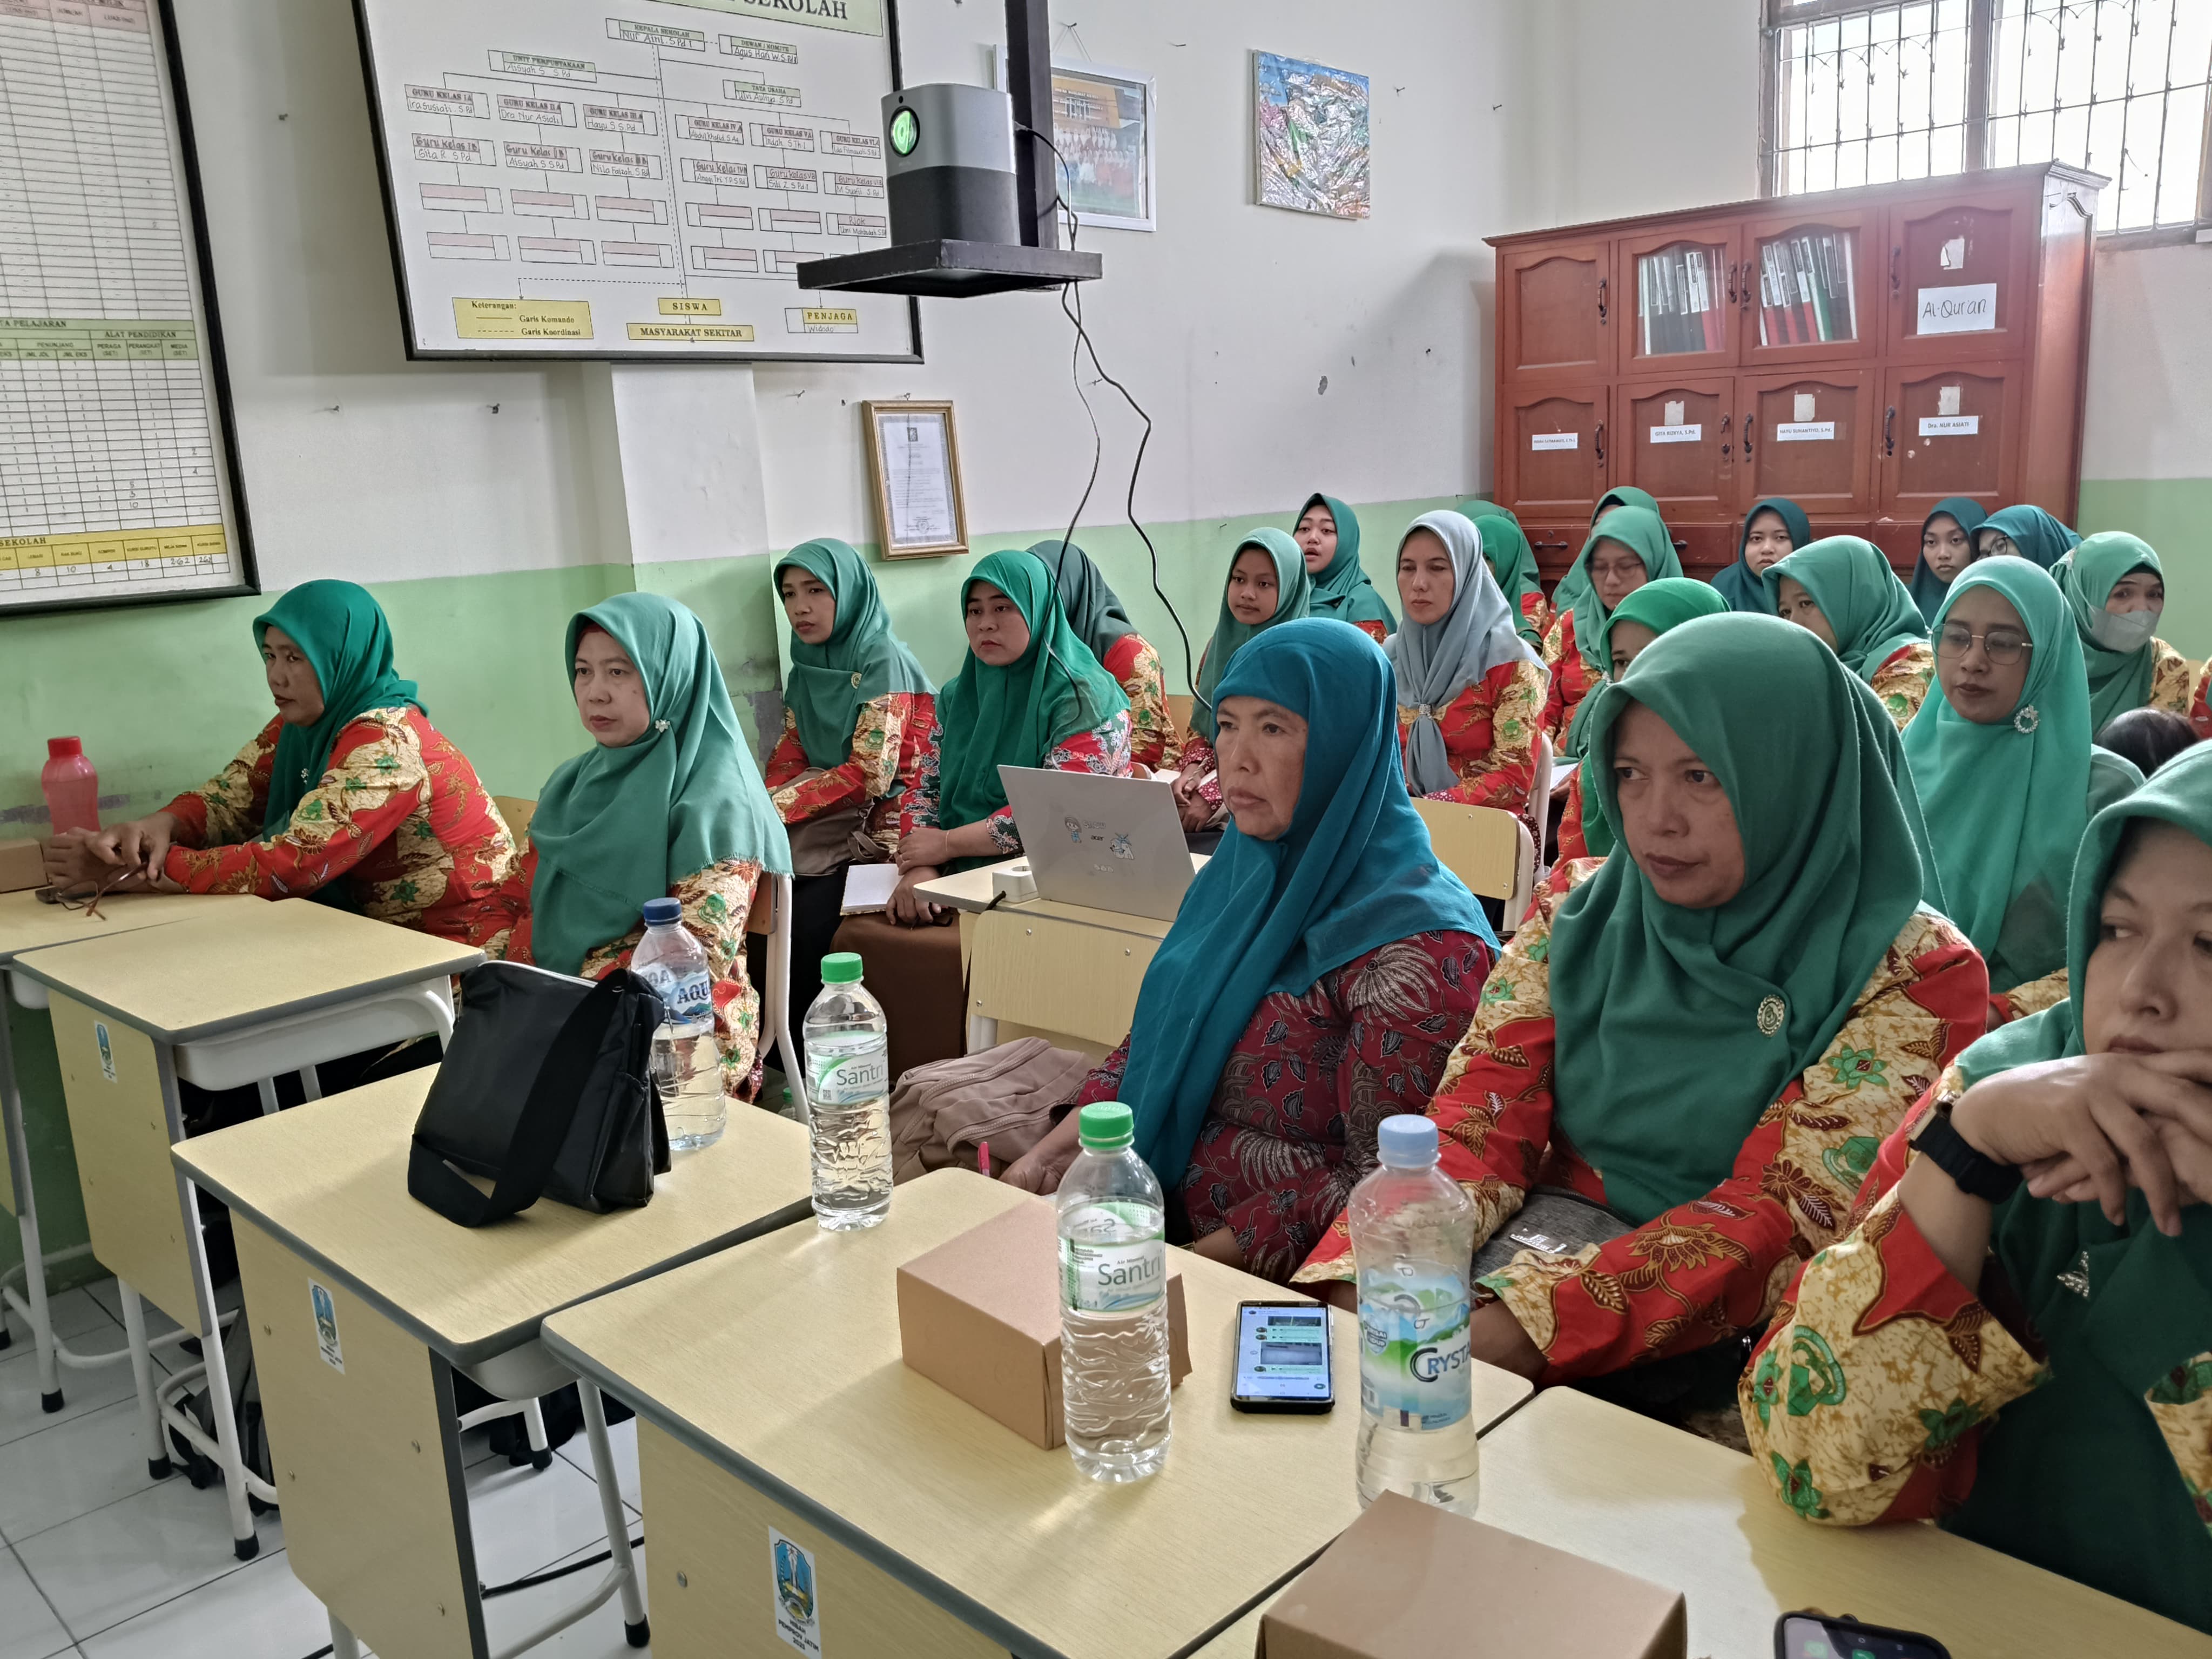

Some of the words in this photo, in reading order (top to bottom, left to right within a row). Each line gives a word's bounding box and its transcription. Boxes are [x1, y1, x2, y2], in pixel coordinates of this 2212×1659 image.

[635, 24, 659, 33] KEPALA
[660, 29, 690, 38] SEKOLAH
[412, 89, 434, 97] GURU
[436, 91, 461, 100] KELAS
[504, 98, 523, 106] GURU
[525, 100, 548, 110] KELAS
[590, 108, 607, 116] GURU
[609, 110, 628, 118] KELAS
[712, 122, 729, 130] KELAS
[416, 136, 440, 147] Guru
[442, 139, 466, 150] Kelas
[506, 144, 528, 155] Guru
[530, 146, 550, 156] Kelas
[592, 152, 611, 160] Guru
[612, 152, 633, 163] Kelas
[697, 161, 714, 171] Guru
[716, 163, 736, 173] Kelas
[770, 168, 787, 178] Guru
[839, 176, 855, 184] Guru
[471, 301, 517, 310] Keterangan:
[673, 302, 707, 311] SISWA
[14, 320, 66, 328] PELAJARAN
[520, 315, 539, 323] Garis
[541, 315, 575, 323] Komando
[640, 328, 701, 336] MASYARAKAT
[704, 328, 742, 337] SEKITAR
[0, 537, 46, 547] SEKOLAH
[677, 980, 710, 1004] AQU
[837, 1064, 883, 1086] Santri
[1098, 1257, 1160, 1286] Santri
